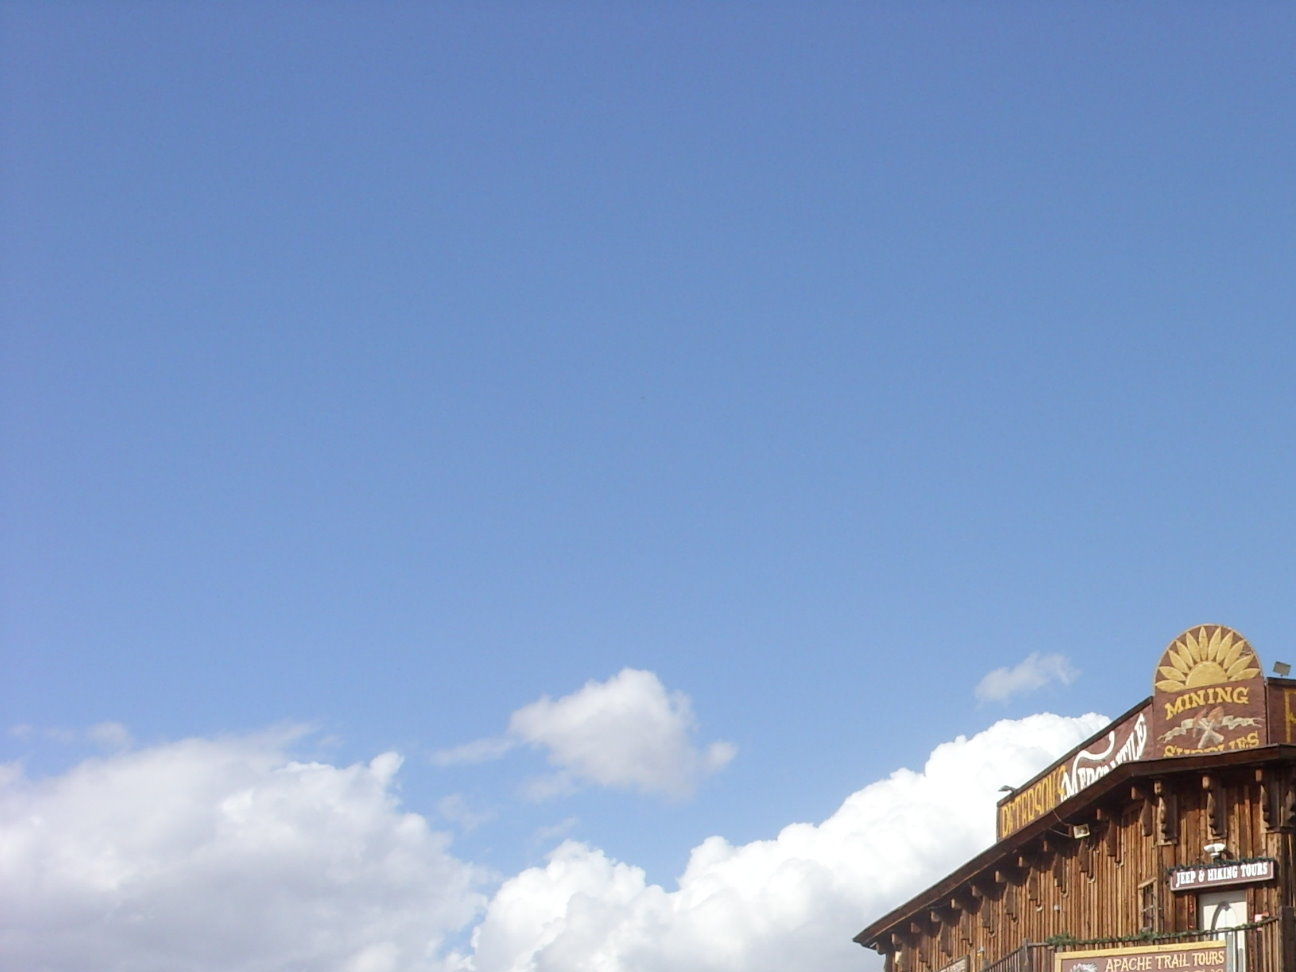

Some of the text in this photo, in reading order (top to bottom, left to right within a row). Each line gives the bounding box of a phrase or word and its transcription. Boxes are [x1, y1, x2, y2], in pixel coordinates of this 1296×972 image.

[1164, 686, 1250, 720] MINING
[1175, 862, 1268, 888] JEEP & HIKING TOURS
[1155, 953, 1190, 970] TRAIL
[1192, 950, 1225, 966] TOURS
